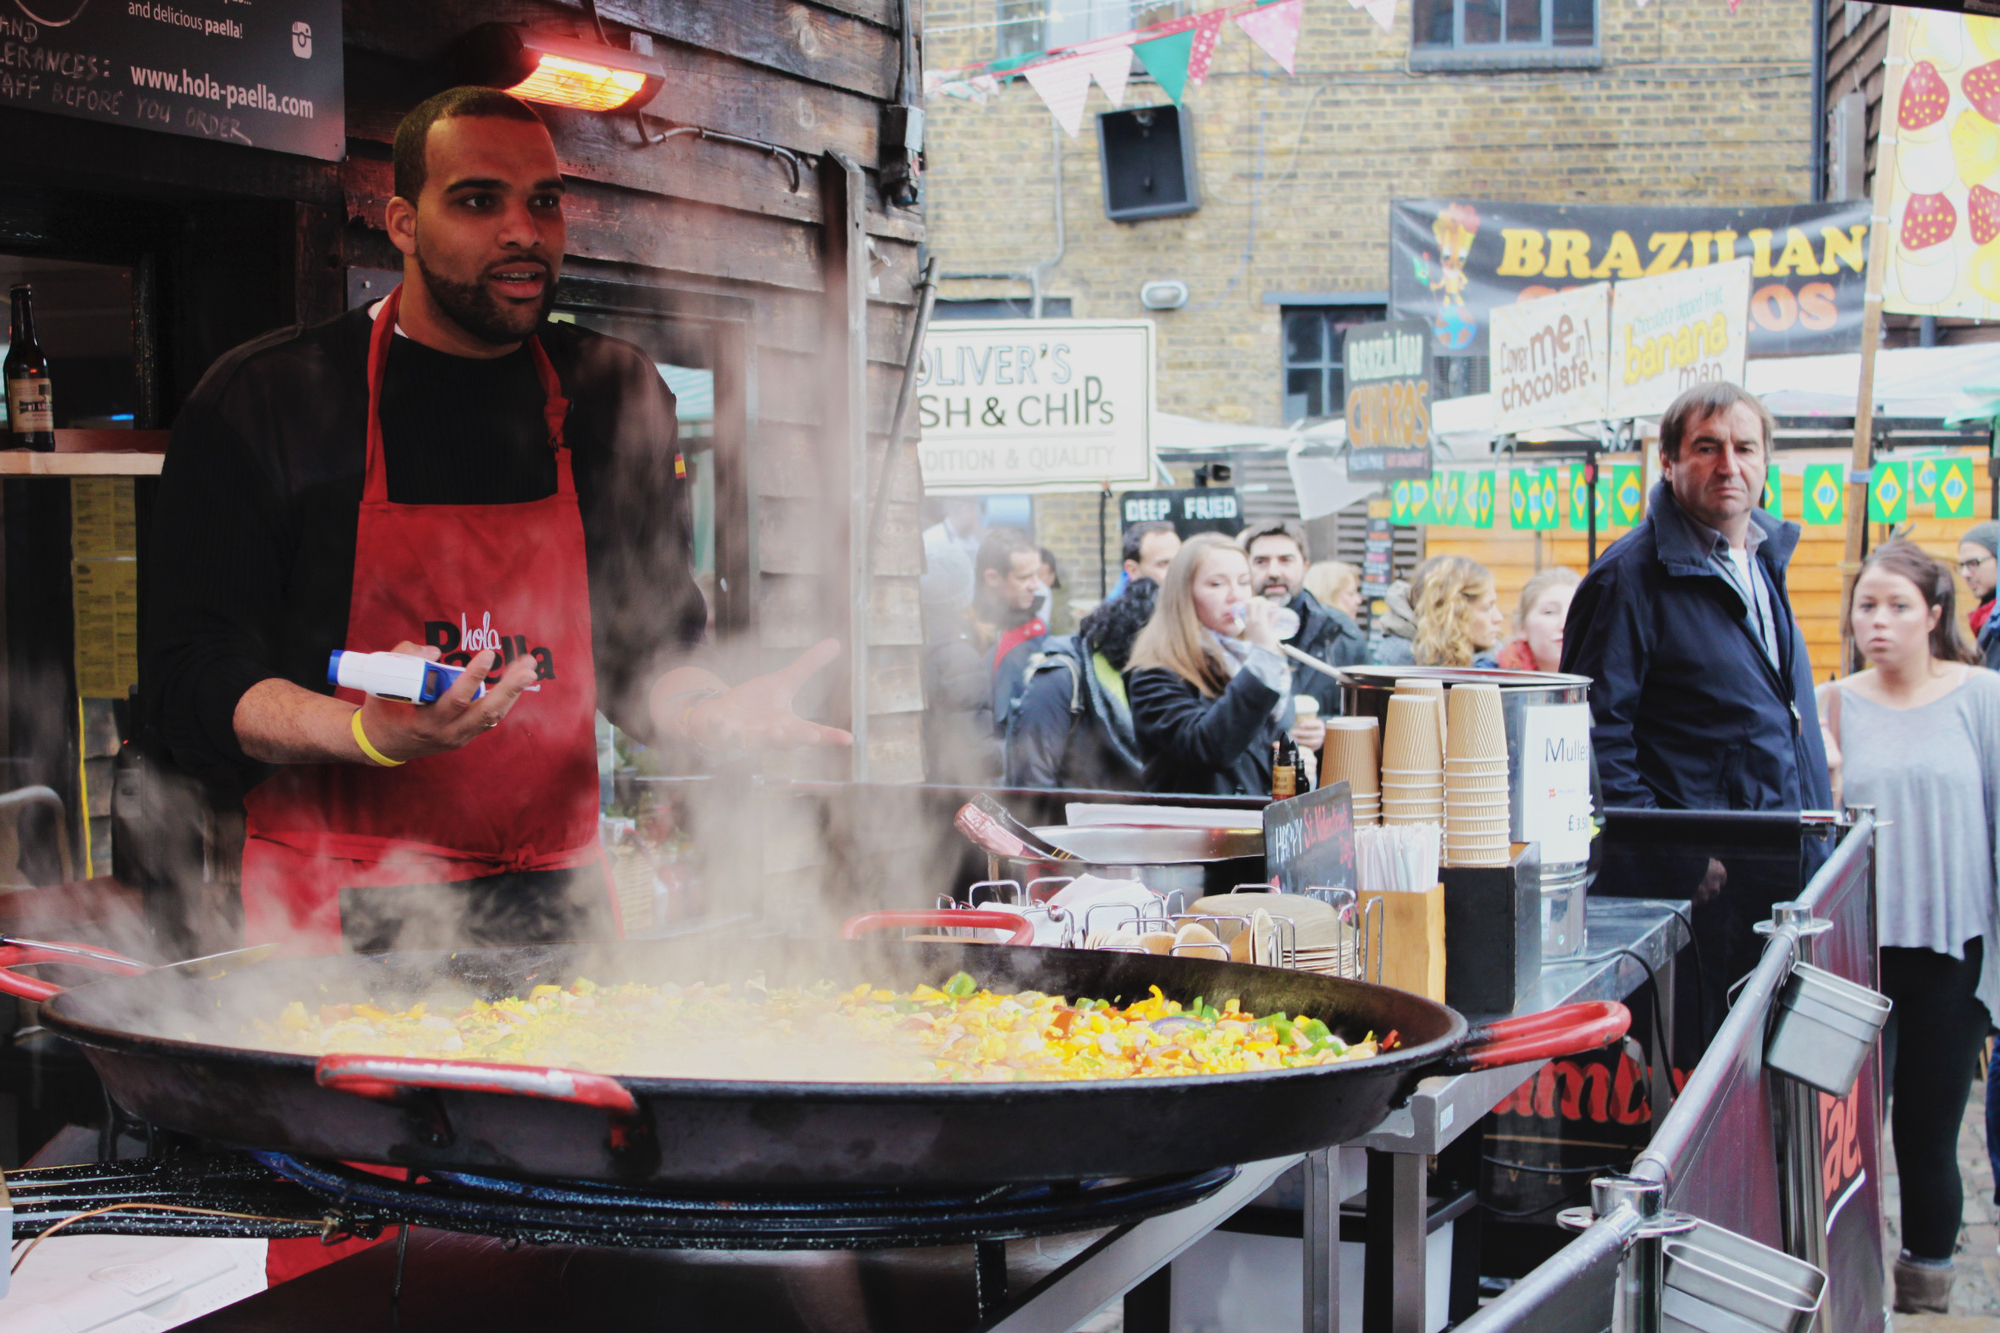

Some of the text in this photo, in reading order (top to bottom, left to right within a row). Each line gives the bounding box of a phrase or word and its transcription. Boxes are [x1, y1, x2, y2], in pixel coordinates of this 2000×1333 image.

[128, 1, 243, 39] and delicious paella!
[0, 41, 110, 81] ERANCES:
[0, 71, 40, 99] AFF
[130, 66, 314, 119] www.hola-paella.com
[1497, 224, 1867, 279] BRAZILIAN
[1530, 314, 1574, 373] me
[1624, 311, 1729, 386] banana
[917, 343, 1073, 387] OLIVER'S
[1678, 362, 1723, 393] man
[980, 396, 1007, 427] &
[1347, 378, 1429, 449] CHURROS
[1028, 446, 1117, 472] QUALITY
[1125, 496, 1237, 521] DEEP FRIED
[461, 611, 502, 651] hola
